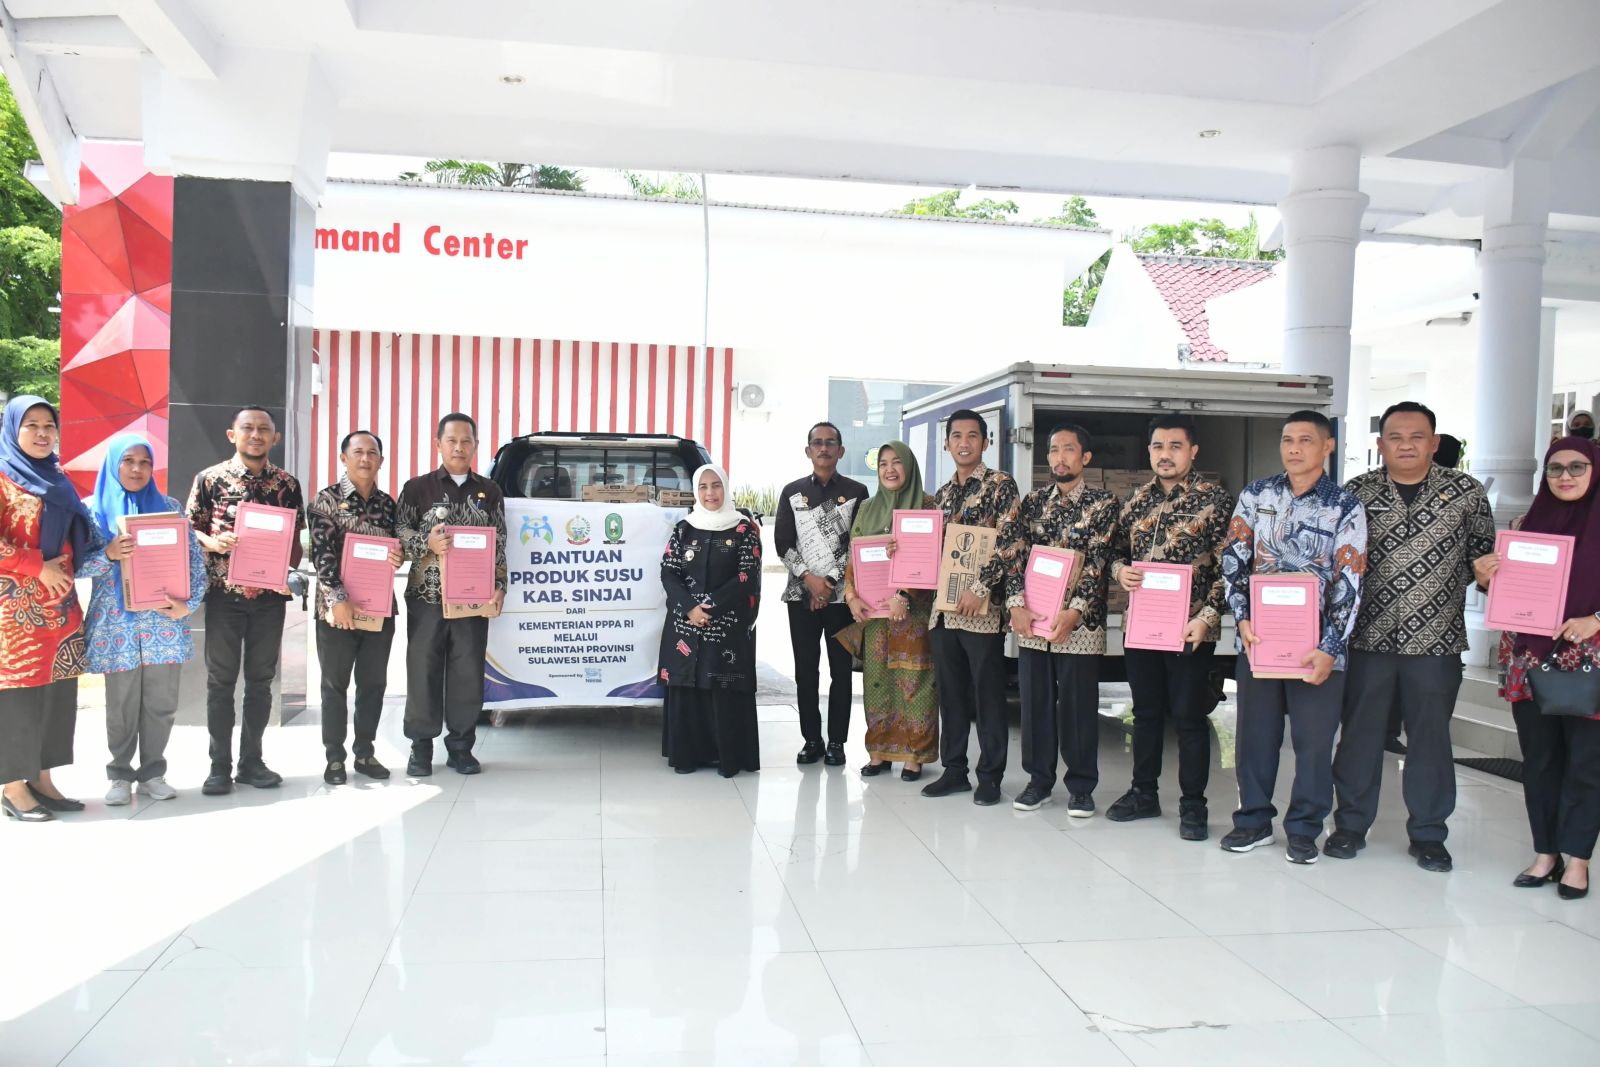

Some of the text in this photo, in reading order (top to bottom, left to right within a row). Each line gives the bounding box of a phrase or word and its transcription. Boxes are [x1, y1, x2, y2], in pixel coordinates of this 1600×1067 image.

[424, 225, 528, 260] Center
[530, 549, 622, 565] BANTUAN
[510, 568, 643, 585] PRODUK SUSU
[523, 587, 632, 604] KAB. SINJAI
[566, 607, 586, 615] DARI
[519, 619, 634, 631] KEMENTERIAN PPPA RI
[554, 633, 598, 642] MELALUI
[518, 644, 634, 654] PEMERINTAH PROVINSI
[528, 655, 627, 665] SULAWESI SELATAN
